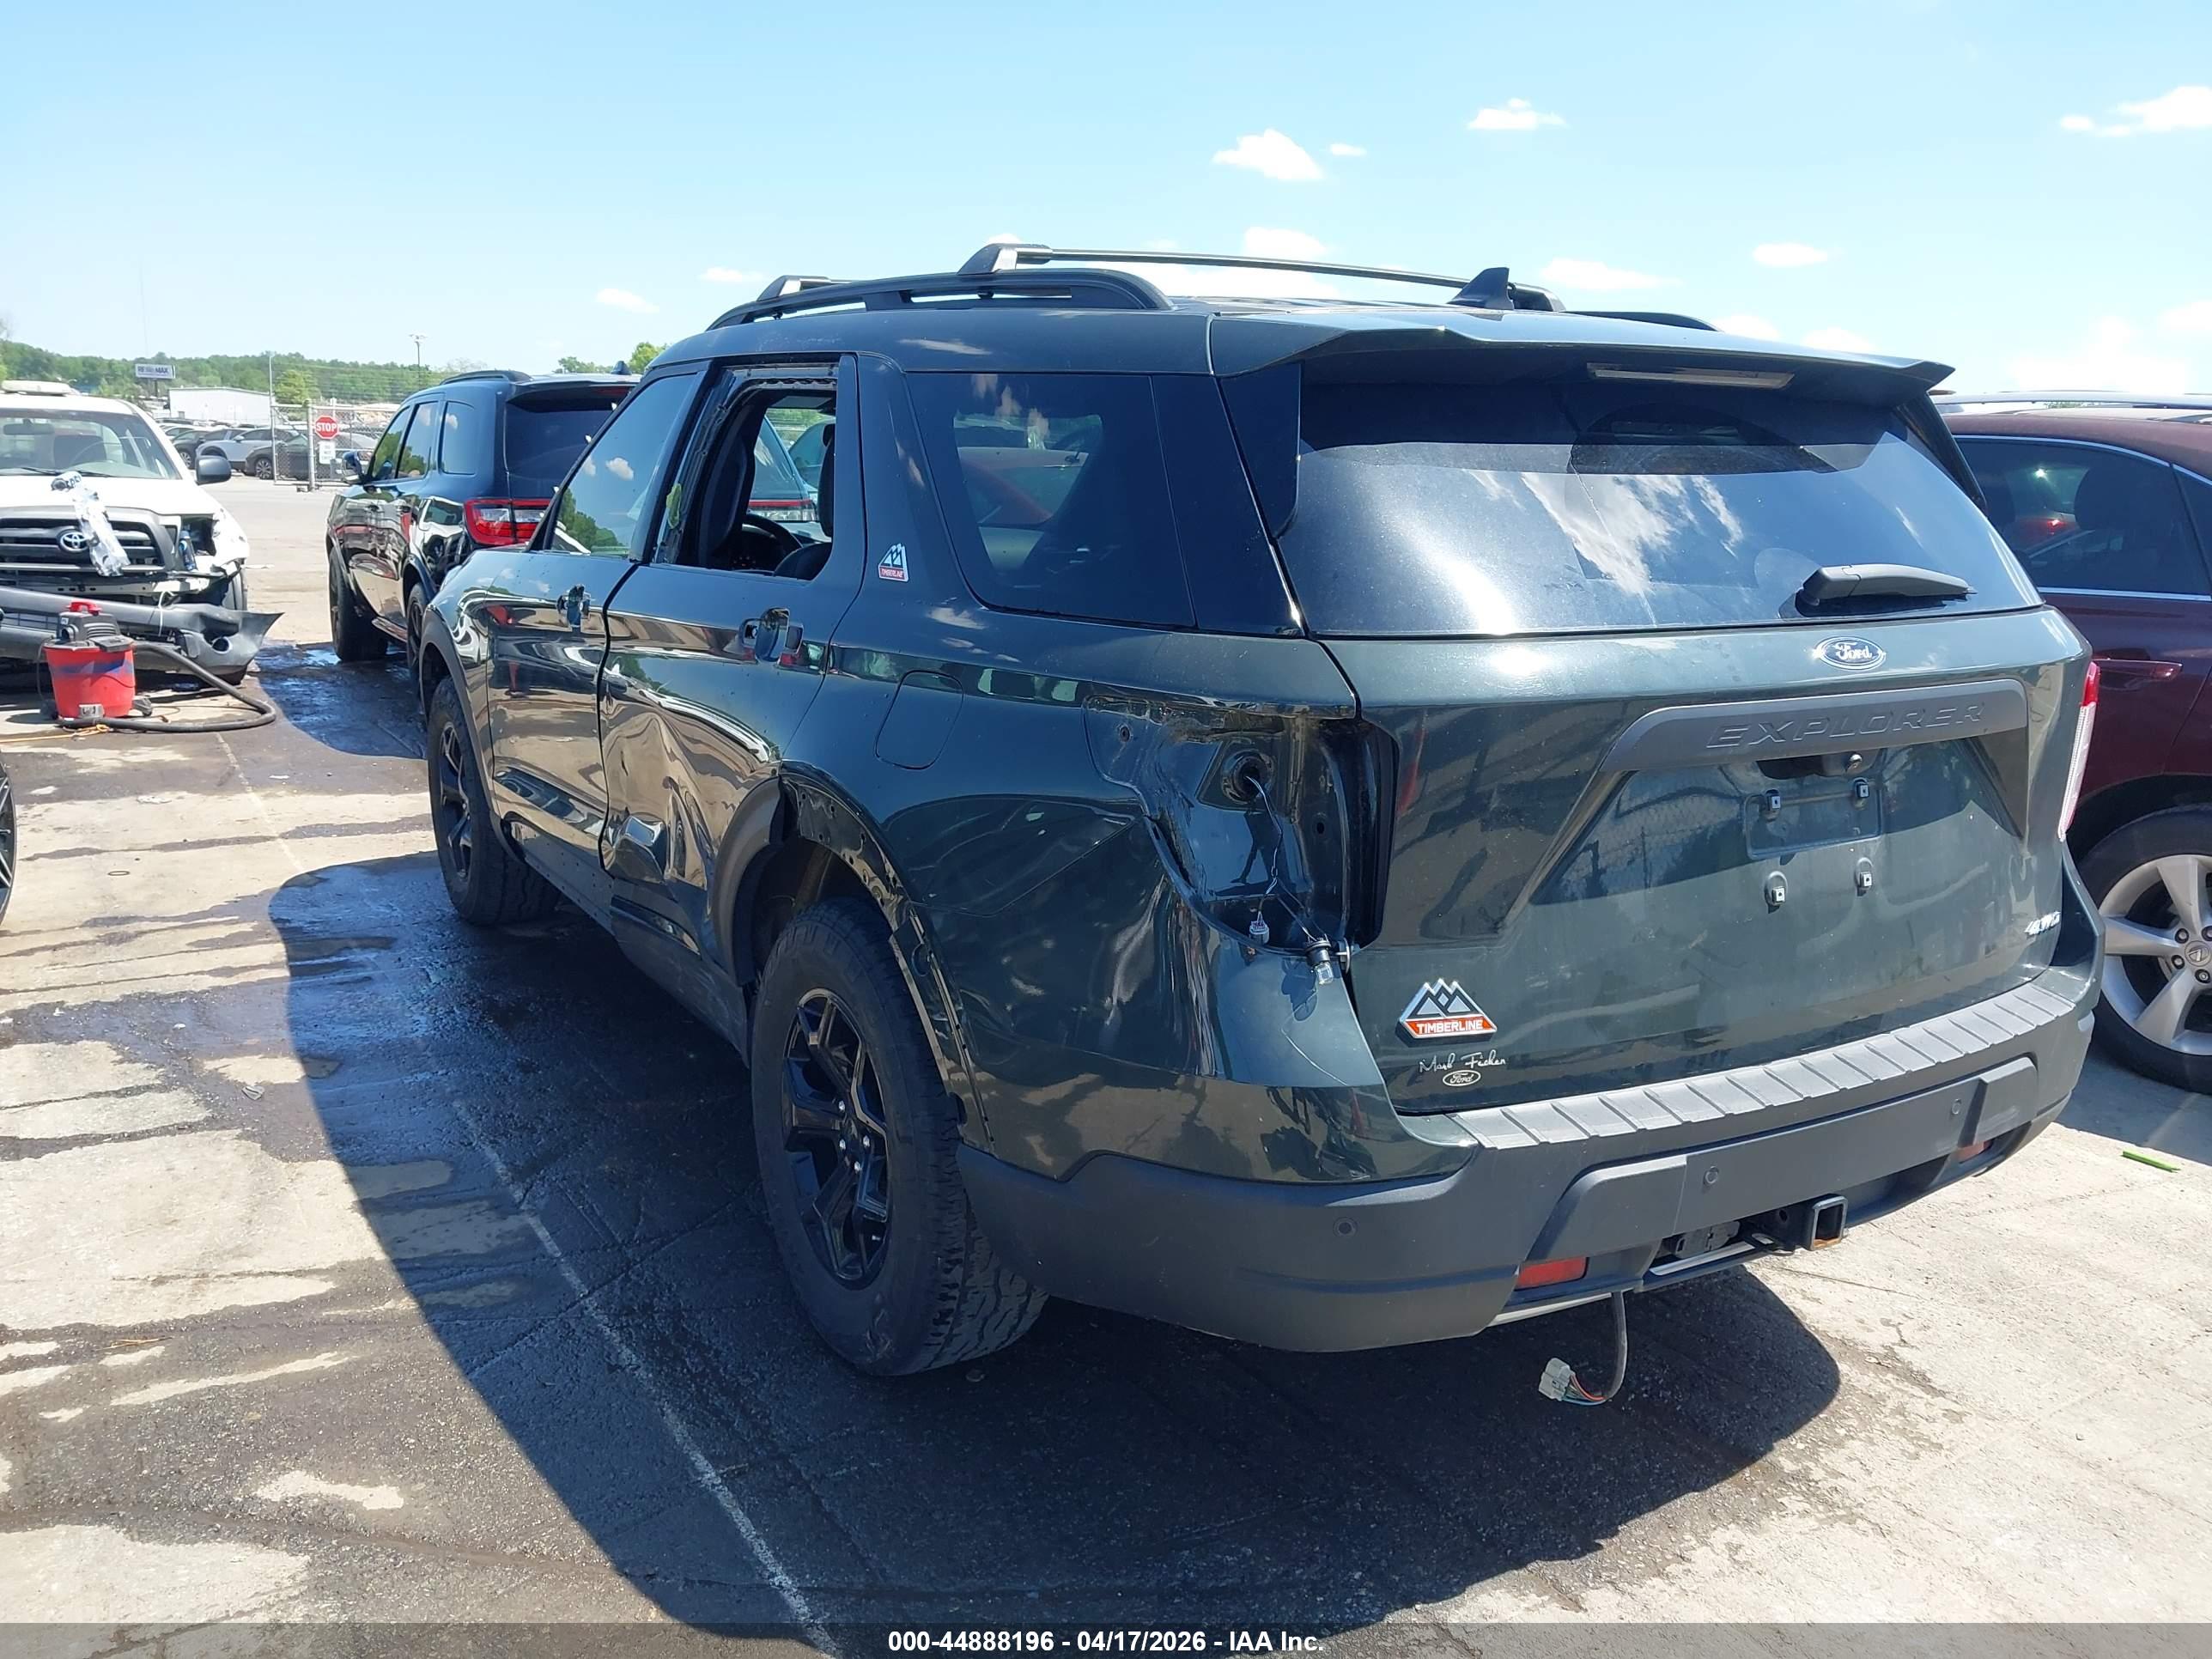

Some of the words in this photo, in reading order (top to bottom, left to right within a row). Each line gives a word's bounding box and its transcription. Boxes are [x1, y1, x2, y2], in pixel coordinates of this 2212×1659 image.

[316, 422, 337, 432] STOP
[1832, 641, 1873, 660] Ford
[1705, 702, 1986, 749] EXPLORER
[1416, 1019, 1484, 1035] TIMBERLINE
[1449, 1073, 1474, 1085] Ford
